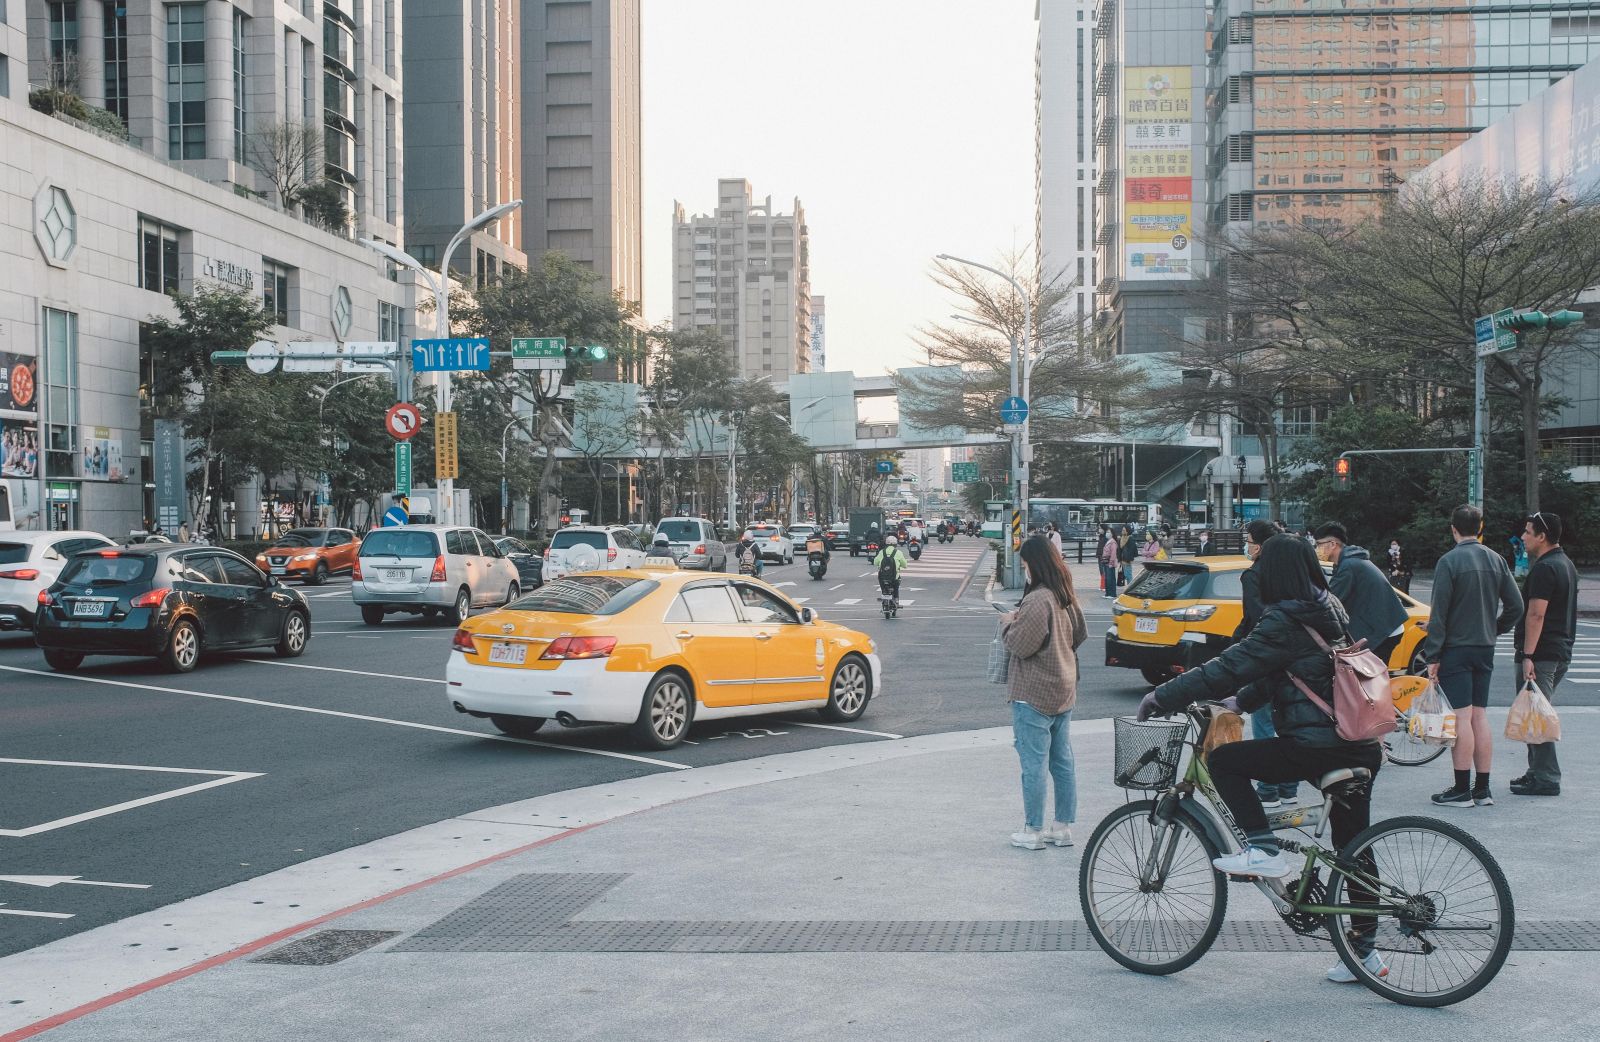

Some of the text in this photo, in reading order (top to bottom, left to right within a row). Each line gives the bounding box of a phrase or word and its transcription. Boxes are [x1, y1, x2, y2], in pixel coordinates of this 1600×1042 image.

[1136, 125, 1181, 138] 囍宴軒
[1173, 237, 1186, 248] 5F
[518, 340, 559, 349] 新府路
